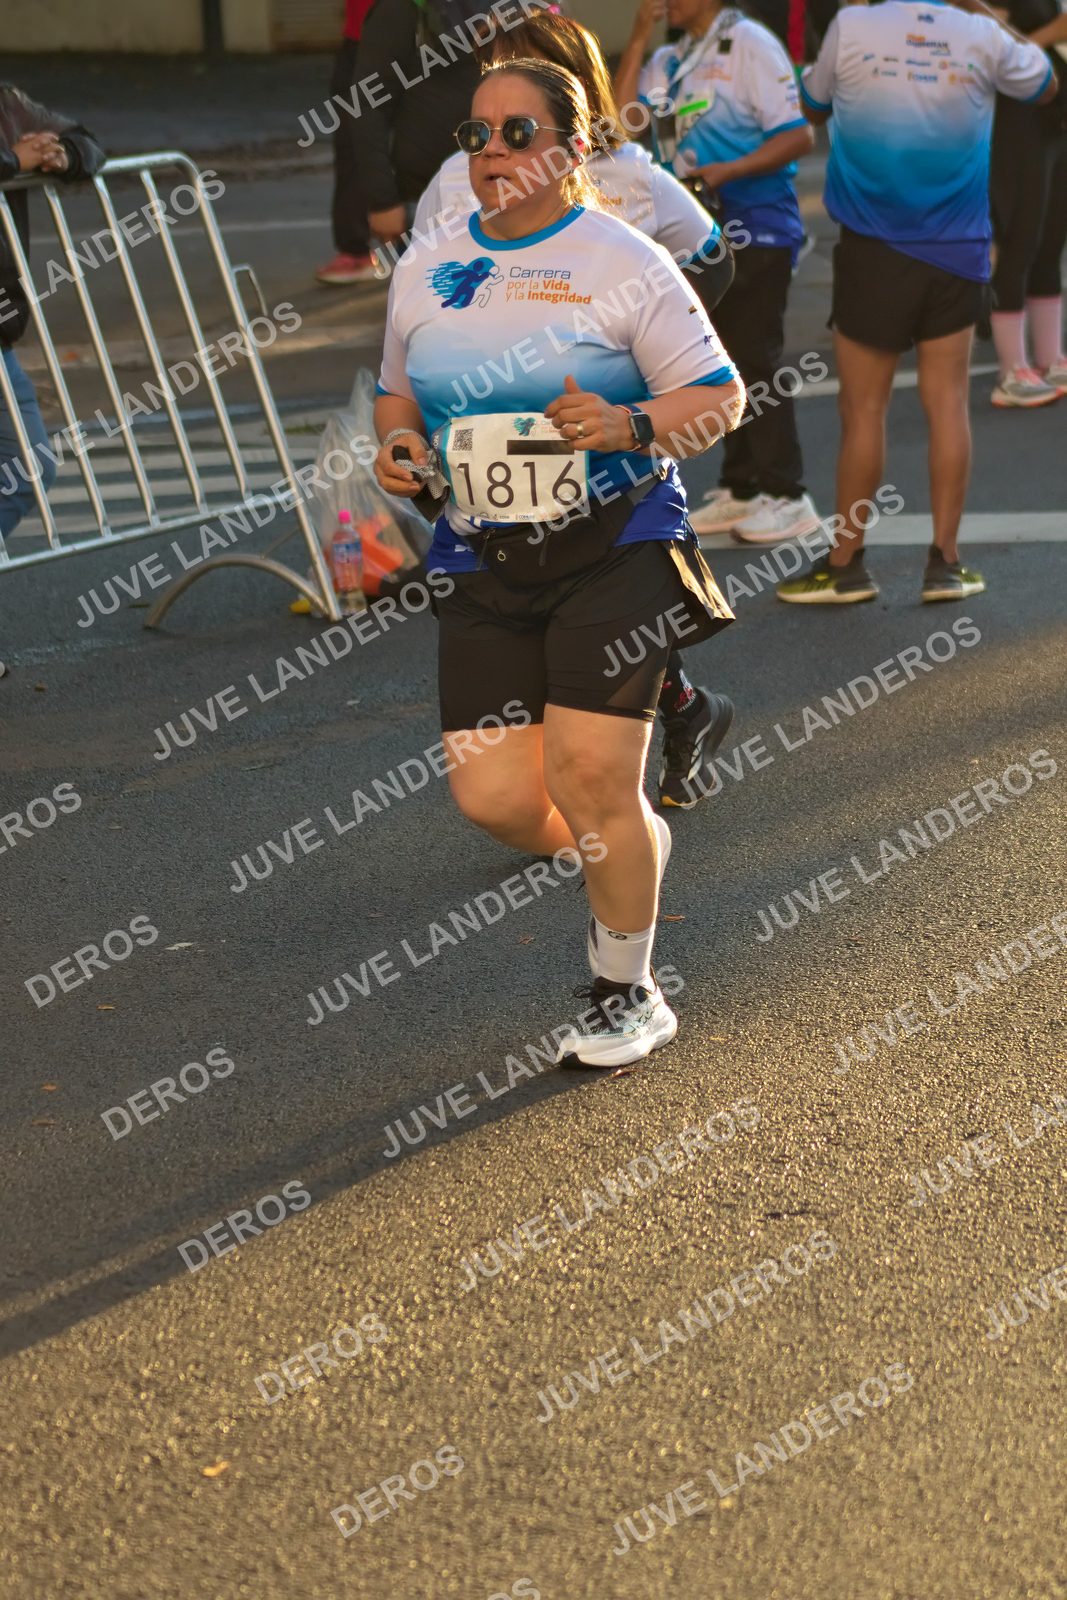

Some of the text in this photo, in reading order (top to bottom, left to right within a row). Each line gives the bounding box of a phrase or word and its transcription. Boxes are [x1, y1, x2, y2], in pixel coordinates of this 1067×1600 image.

[509, 266, 571, 280] Carrera
[507, 279, 570, 291] por la Vida
[505, 290, 592, 305] y la Integridad
[457, 460, 582, 509] 1816
